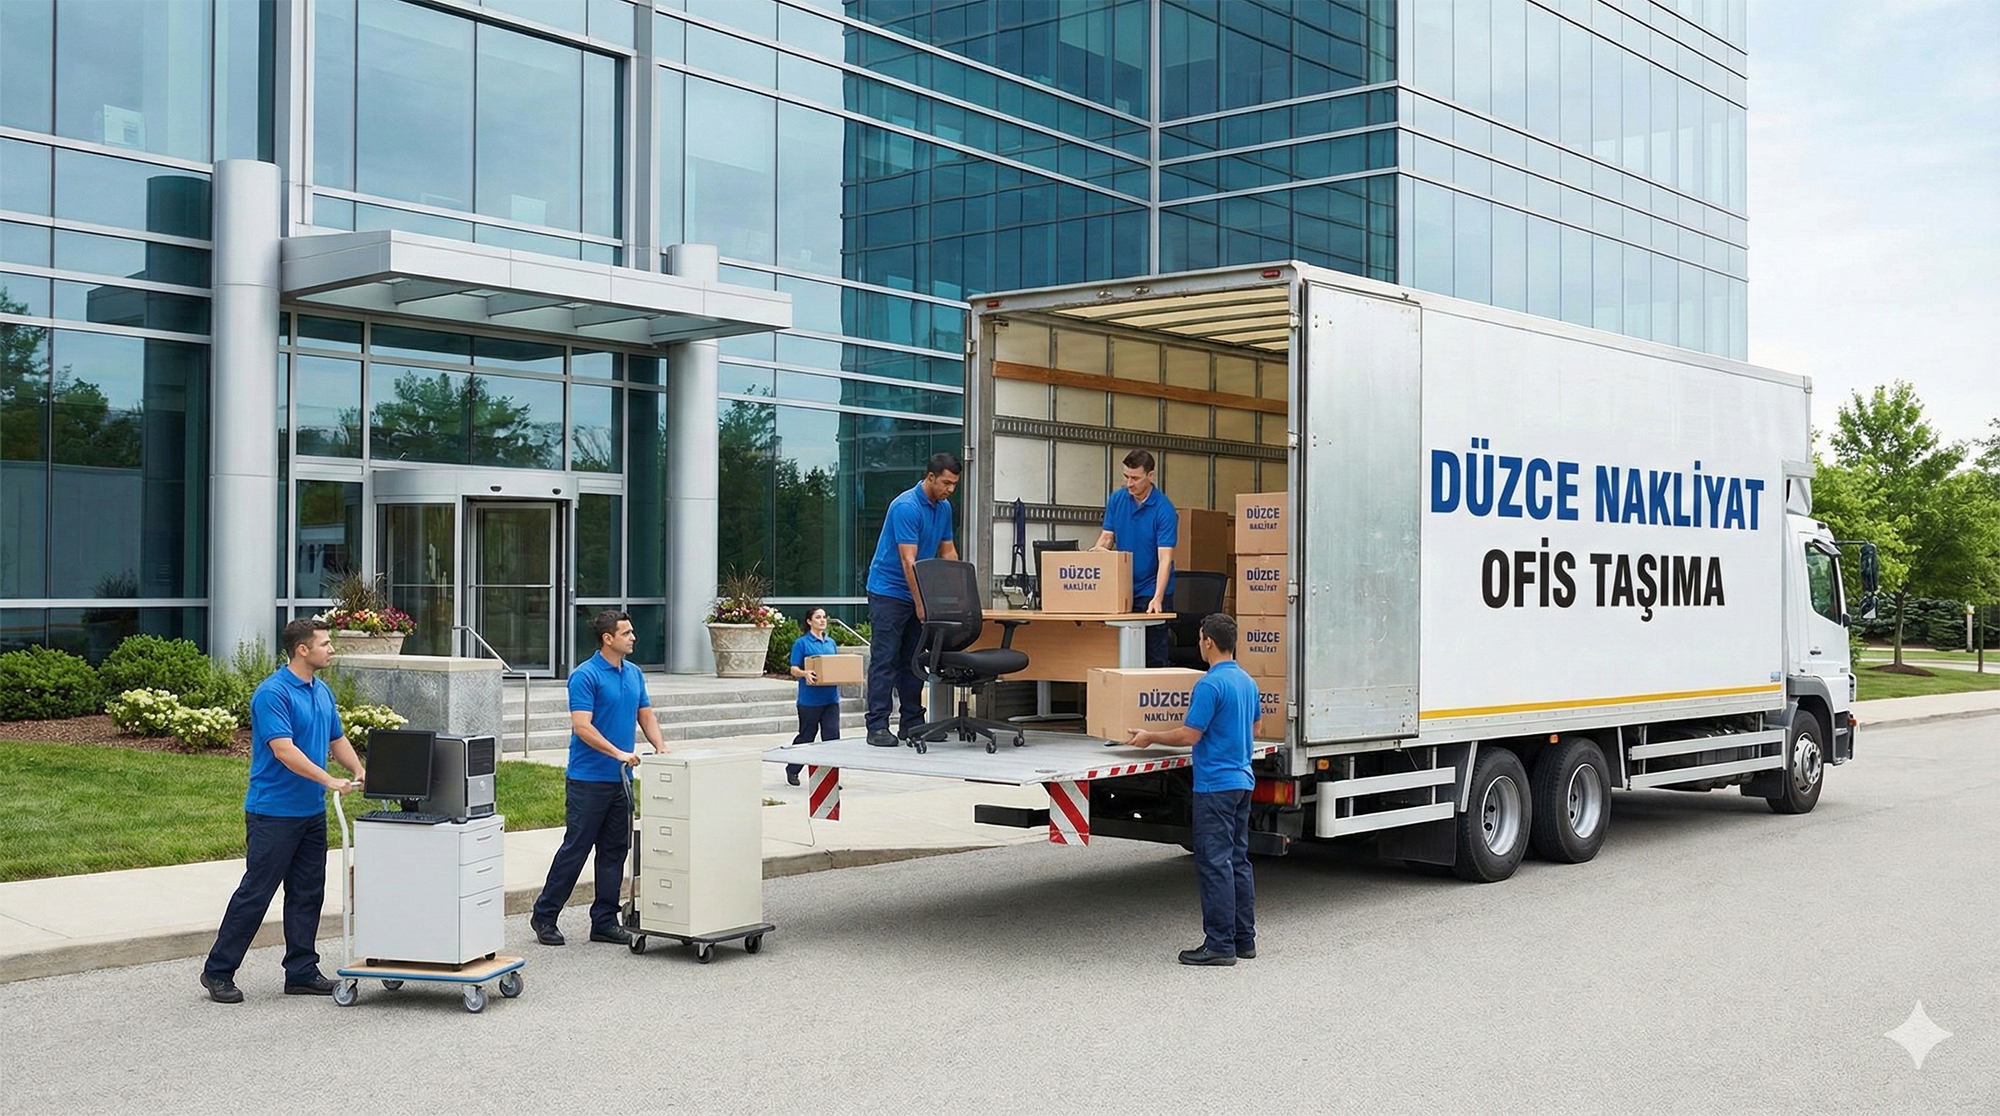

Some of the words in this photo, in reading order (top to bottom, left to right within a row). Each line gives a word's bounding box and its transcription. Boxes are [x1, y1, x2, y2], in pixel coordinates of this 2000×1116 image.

[1431, 437, 1579, 520] DÜZCE
[1595, 460, 1764, 530] NAKLİYAT
[1247, 506, 1280, 519] DÜZCE
[1059, 565, 1101, 579] DÜZCE
[1247, 567, 1280, 581] DÜZCE
[1482, 537, 1576, 608] OFİS
[1590, 552, 1725, 622] TAŞIMA
[1247, 630, 1280, 642] DÜZCE
[1139, 689, 1190, 707] DÜZCE
[1260, 693, 1280, 703] ZCE
[1144, 711, 1184, 722] NAKLİYAT
